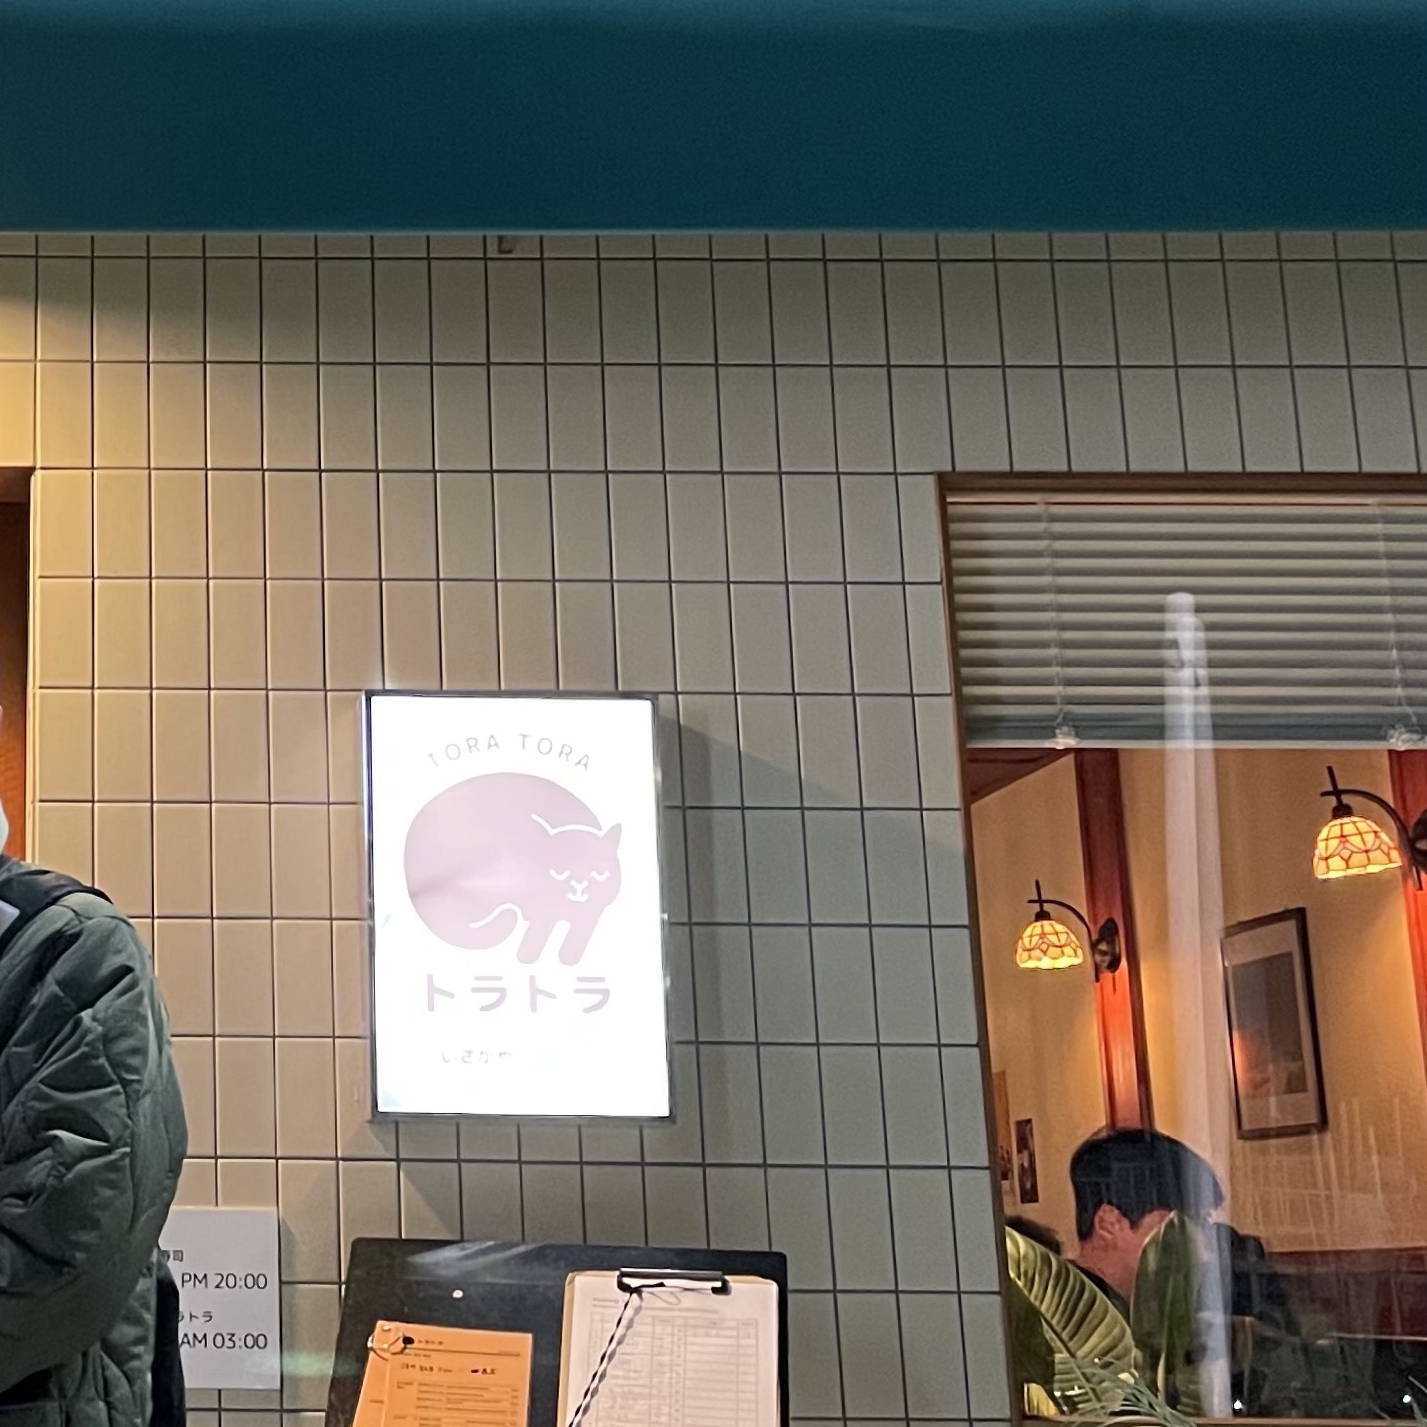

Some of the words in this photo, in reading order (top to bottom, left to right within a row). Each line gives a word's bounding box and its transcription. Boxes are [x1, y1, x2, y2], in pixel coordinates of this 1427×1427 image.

[426, 734, 500, 768] TORA
[518, 733, 591, 771] TORA
[427, 973, 611, 1014] トラトラ
[181, 1272, 209, 1289] PM
[214, 1272, 268, 1290] 20:00
[179, 1332, 208, 1349] AM
[212, 1332, 268, 1350] 03:00
